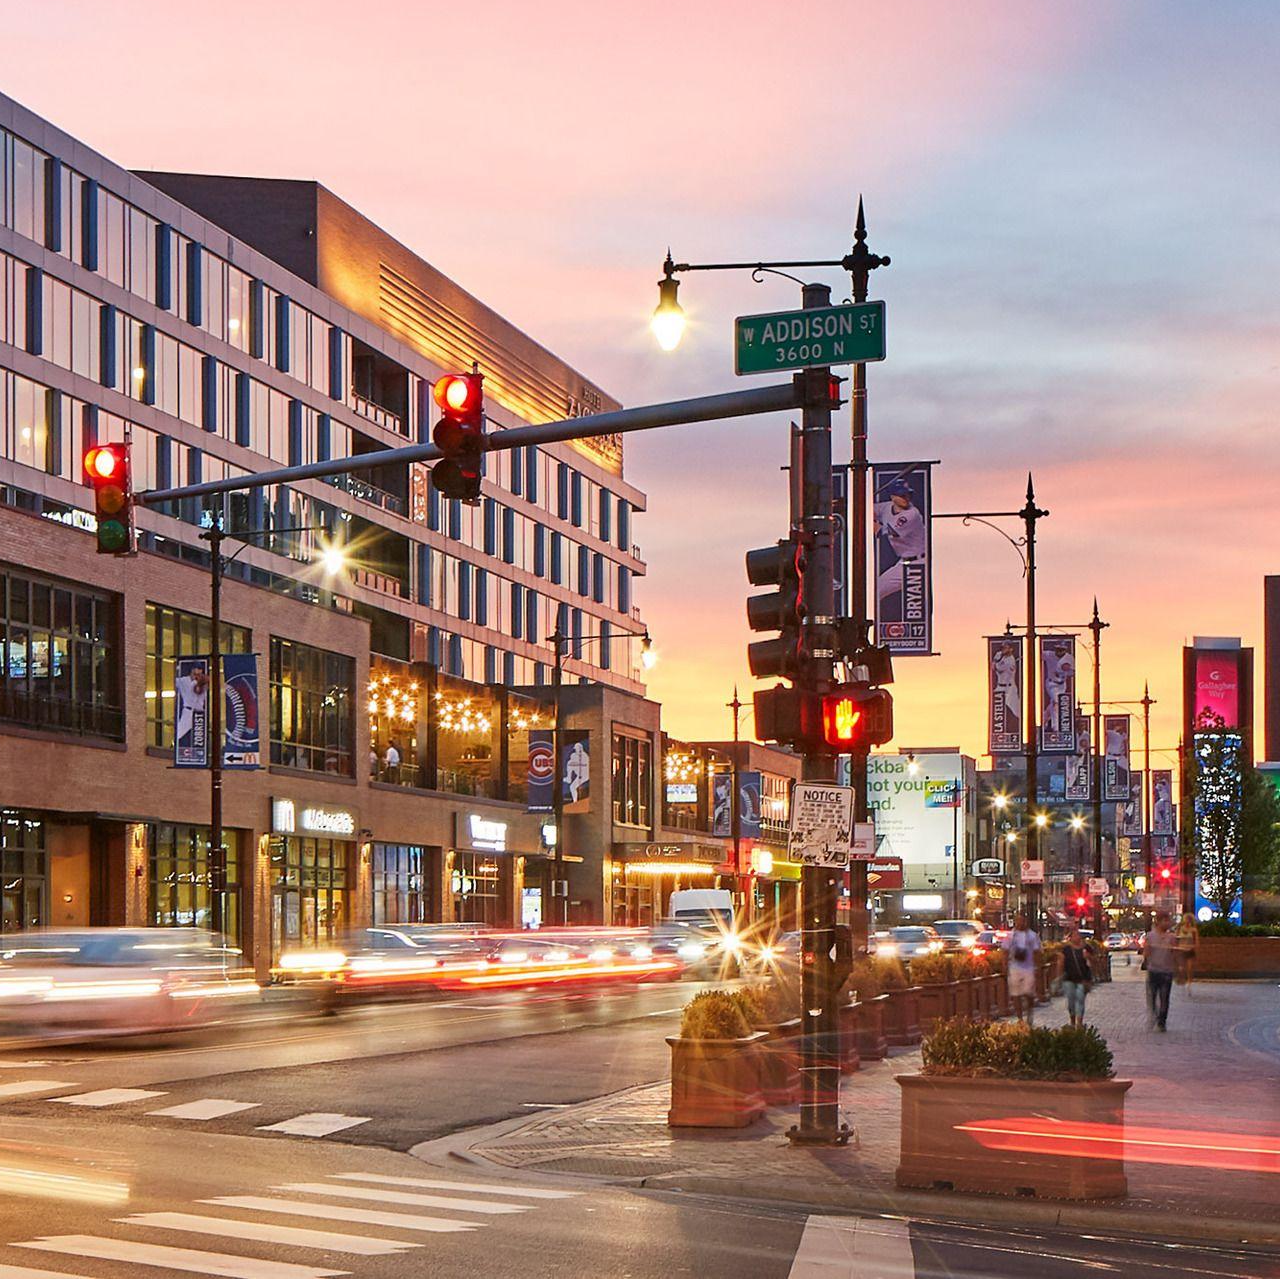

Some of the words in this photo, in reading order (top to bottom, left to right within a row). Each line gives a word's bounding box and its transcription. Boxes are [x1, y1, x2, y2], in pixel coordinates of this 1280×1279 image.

[743, 327, 755, 343] W
[761, 313, 853, 345] ADDISON
[860, 313, 877, 329] ST
[776, 344, 822, 362] 3600
[834, 341, 844, 357] N
[907, 567, 923, 620] BRYANT
[912, 625, 924, 636] 17
[1198, 681, 1236, 691] Gallagher
[994, 693, 1004, 721] STELLA
[1060, 695, 1070, 732] HEYWARD
[194, 713, 204, 747] ZOBRIST
[994, 722, 1004, 733] LA
[1079, 767, 1087, 786] HAPP
[803, 790, 842, 802] NOTICE
[894, 780, 931, 794] your
